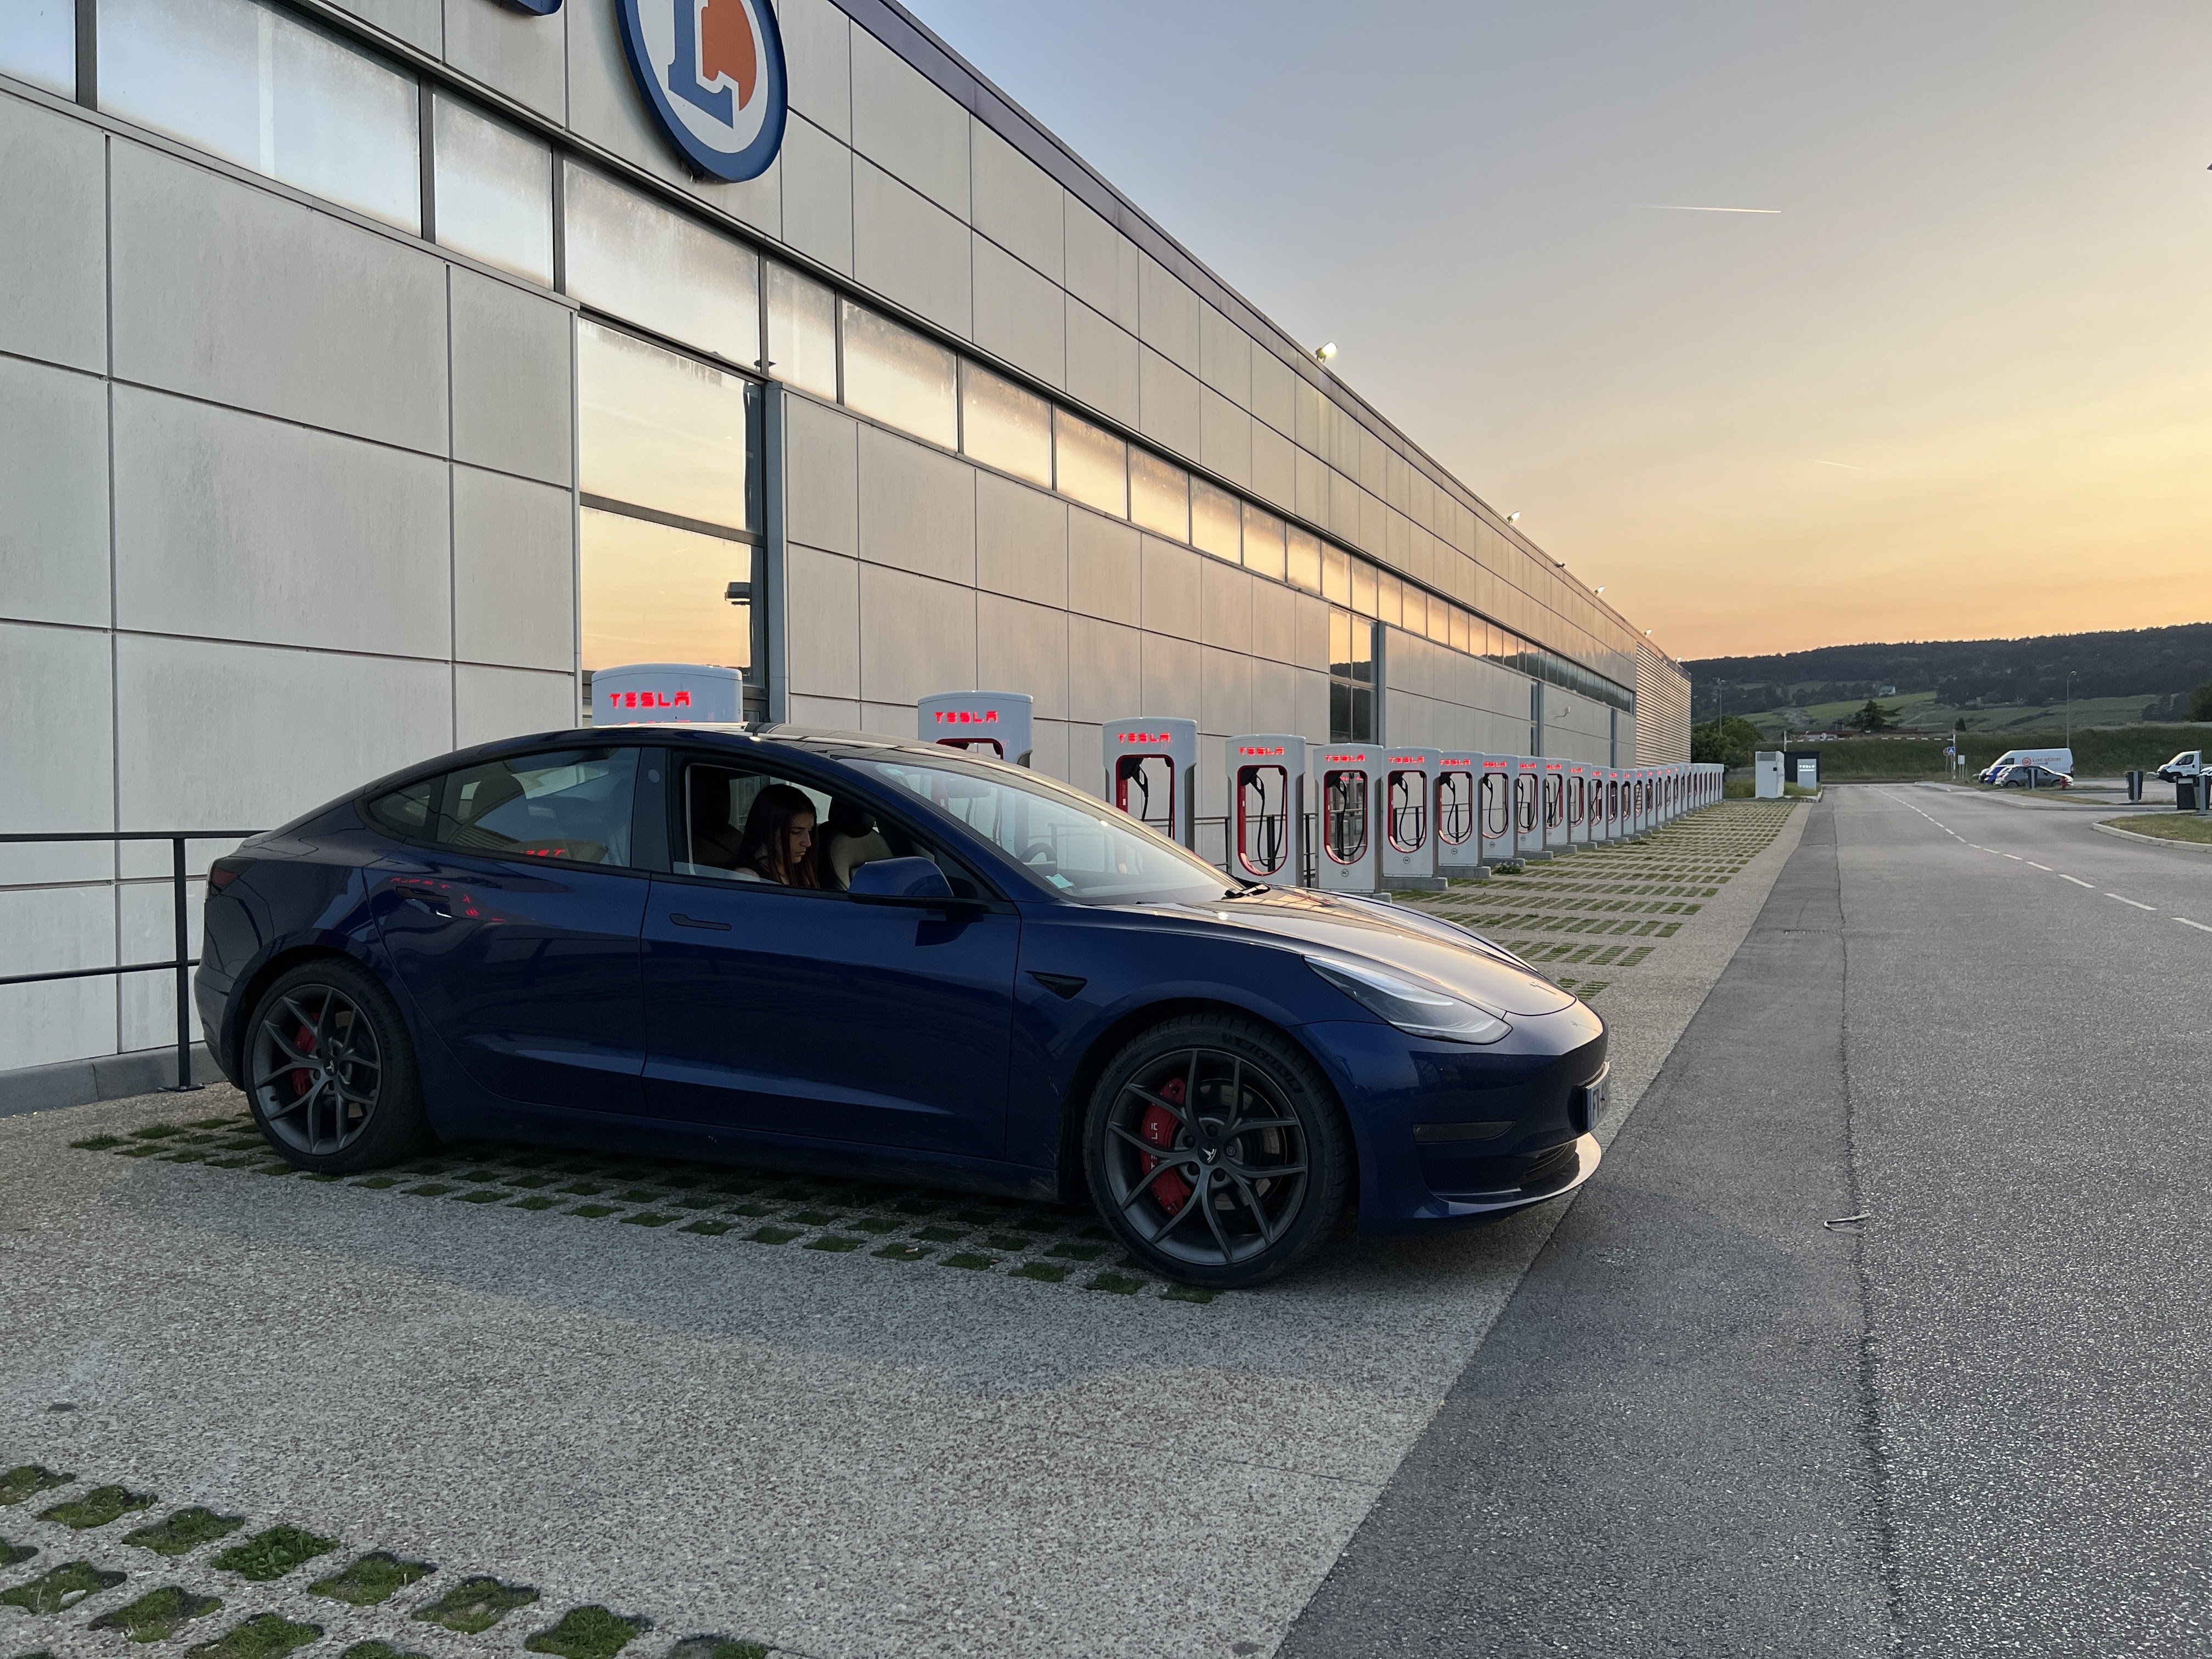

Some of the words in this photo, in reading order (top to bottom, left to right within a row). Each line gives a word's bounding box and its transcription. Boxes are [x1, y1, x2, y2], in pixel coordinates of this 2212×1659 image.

[608, 691, 691, 709] TESLA
[934, 710, 999, 724] TESLA
[1117, 732, 1171, 743] TESLA
[1238, 747, 1285, 756] TESLA
[1325, 754, 1365, 763] TESLA
